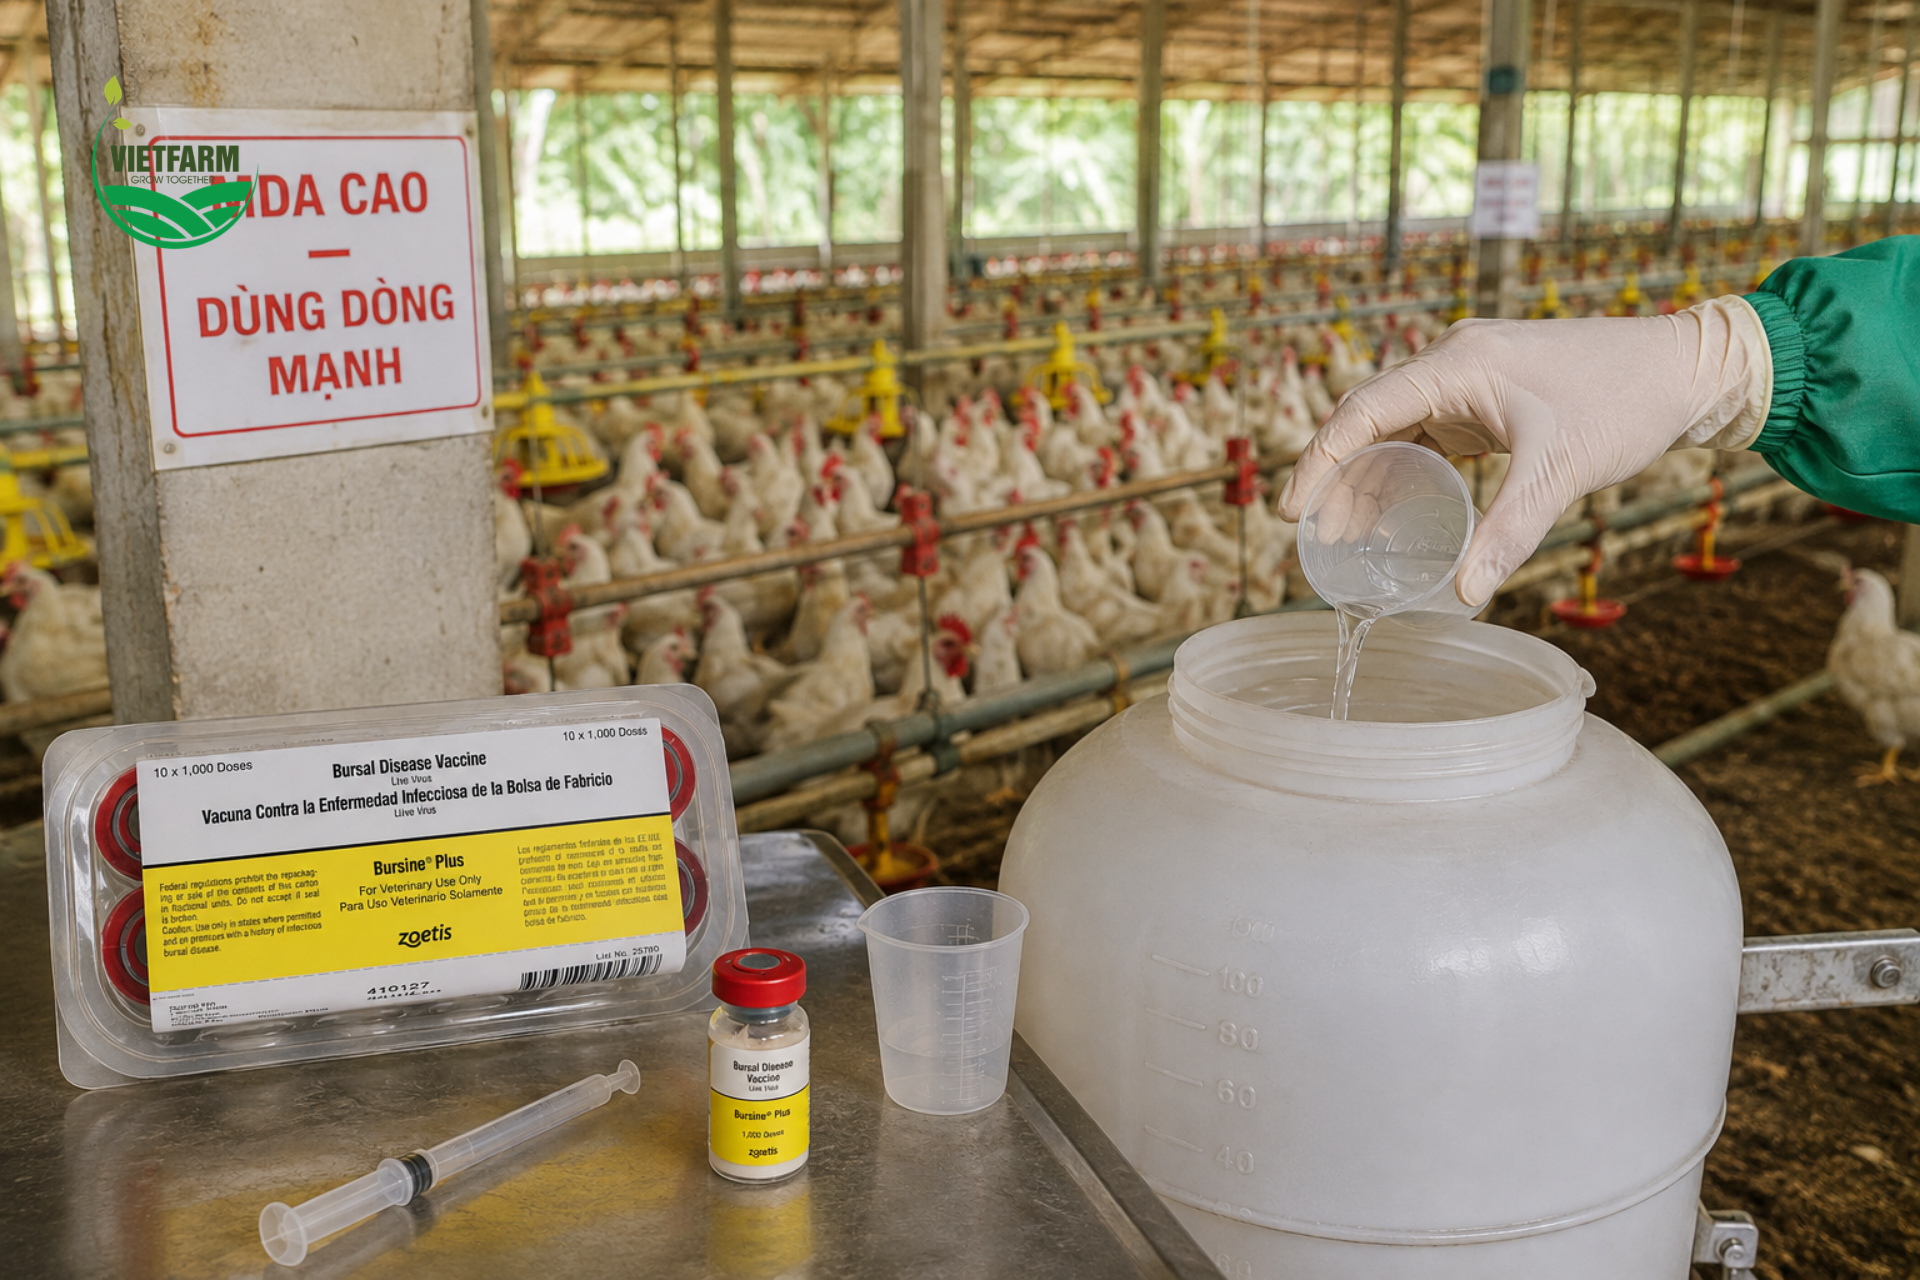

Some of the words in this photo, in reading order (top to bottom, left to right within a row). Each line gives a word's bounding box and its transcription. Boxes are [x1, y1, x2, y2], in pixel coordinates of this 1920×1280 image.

[339, 170, 428, 216] CAO
[197, 284, 326, 338] DÙNG
[341, 277, 455, 328] DÒNG
[267, 346, 402, 401] MẠNH
[563, 731, 576, 741] 10
[578, 732, 585, 740] x
[588, 727, 616, 740] 1,000
[154, 766, 168, 778] 10
[171, 767, 178, 777] x
[182, 763, 214, 777] 1,000
[217, 760, 253, 773] Doses
[332, 759, 376, 779] Bursal
[379, 757, 432, 775] Disease
[435, 751, 487, 770] Vaccine
[202, 807, 252, 825] Vacuna
[255, 802, 299, 820] Contra
[303, 799, 315, 815] la
[319, 791, 398, 813] Enfermedad
[402, 785, 468, 804] Infecciosa
[472, 781, 487, 797] de
[491, 780, 503, 795] la
[507, 776, 542, 794] Bolsa
[545, 774, 560, 791] de
[564, 771, 613, 789] Fabricio
[435, 853, 465, 870] Plus
[339, 901, 364, 912] Para
[367, 898, 388, 909] Uso
[390, 892, 446, 907] Veterinario
[450, 886, 503, 900] Solamente
[359, 885, 377, 896] For
[380, 880, 433, 895] Veterinary
[435, 878, 456, 888] Use
[459, 874, 482, 886] Only
[398, 924, 452, 948] zoetis
[1219, 965, 1264, 999] 100
[1217, 1019, 1259, 1052] 80
[1216, 1077, 1257, 1111] 60
[1215, 1145, 1256, 1176] 40
